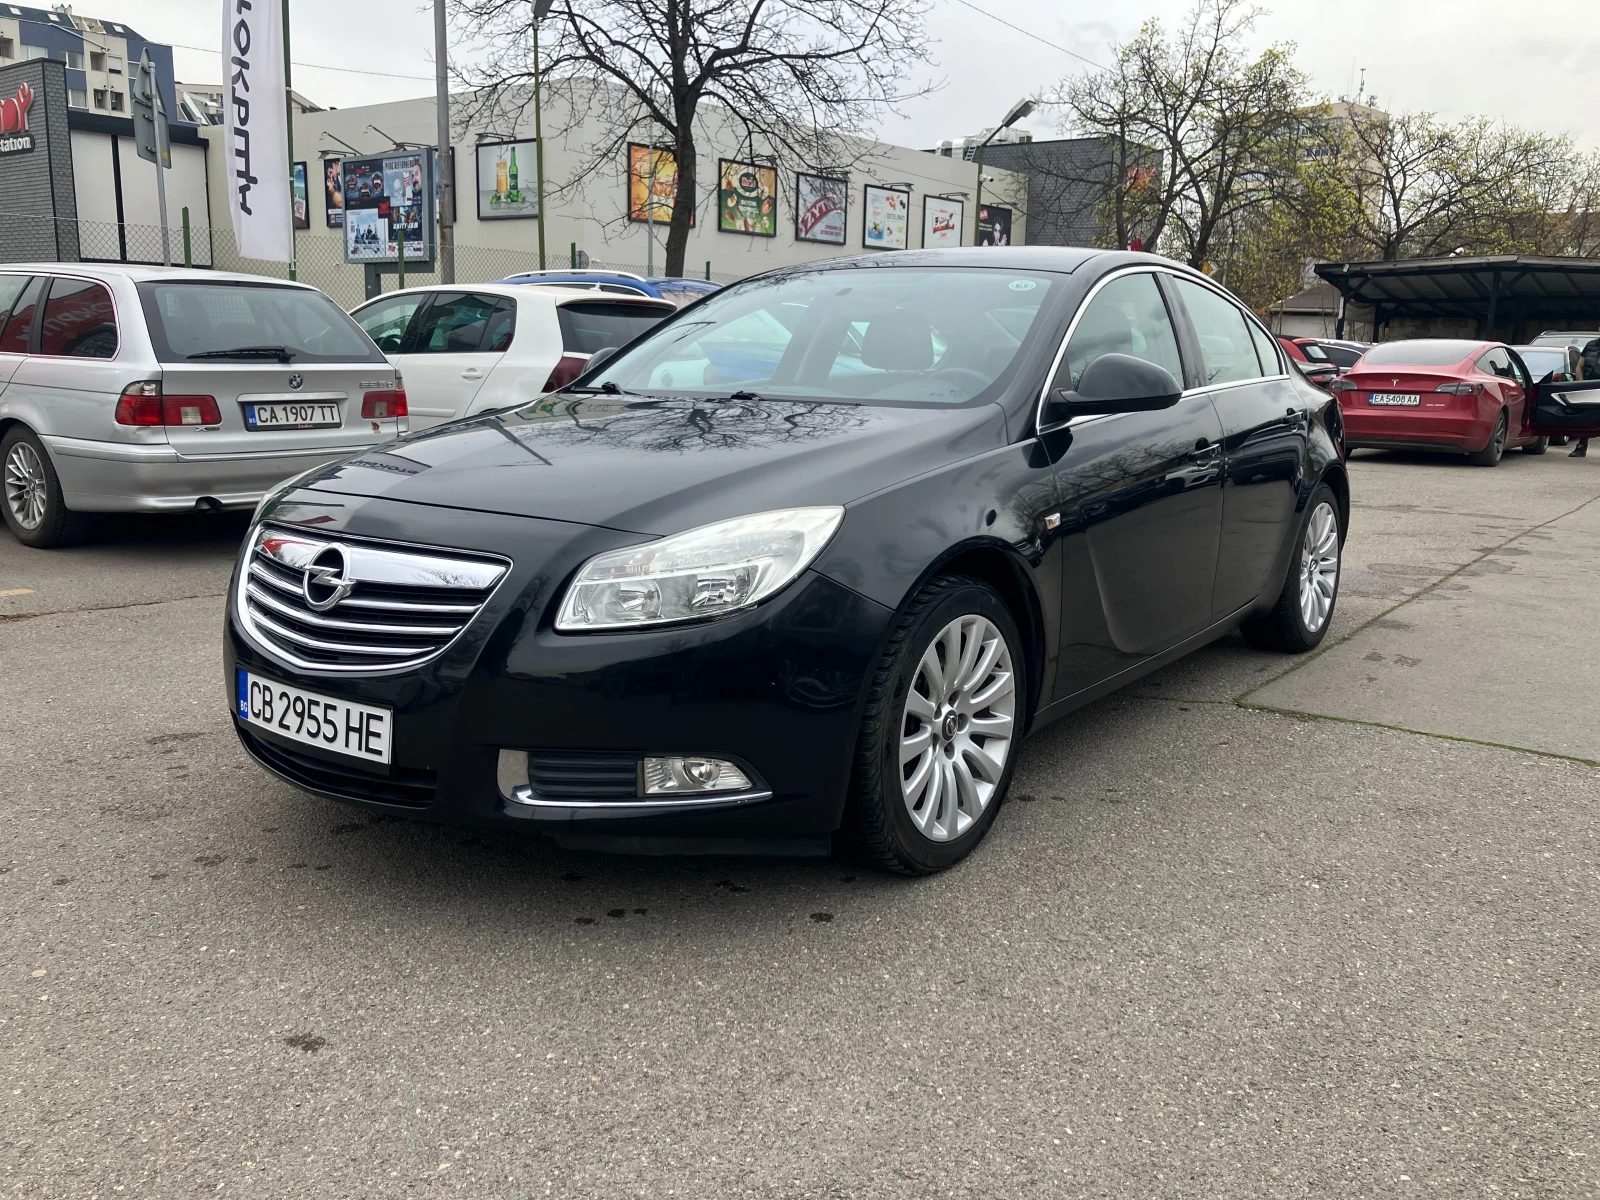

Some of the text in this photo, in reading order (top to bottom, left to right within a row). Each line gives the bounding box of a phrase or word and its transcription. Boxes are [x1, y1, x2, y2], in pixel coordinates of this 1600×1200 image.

[0, 136, 31, 152] tation
[1386, 395, 1405, 403] 5408
[1407, 395, 1417, 403] AA
[257, 405, 279, 422] CA
[282, 404, 315, 422] 1907
[318, 405, 337, 421] TT
[240, 680, 384, 757] BG CB 2955 HE
